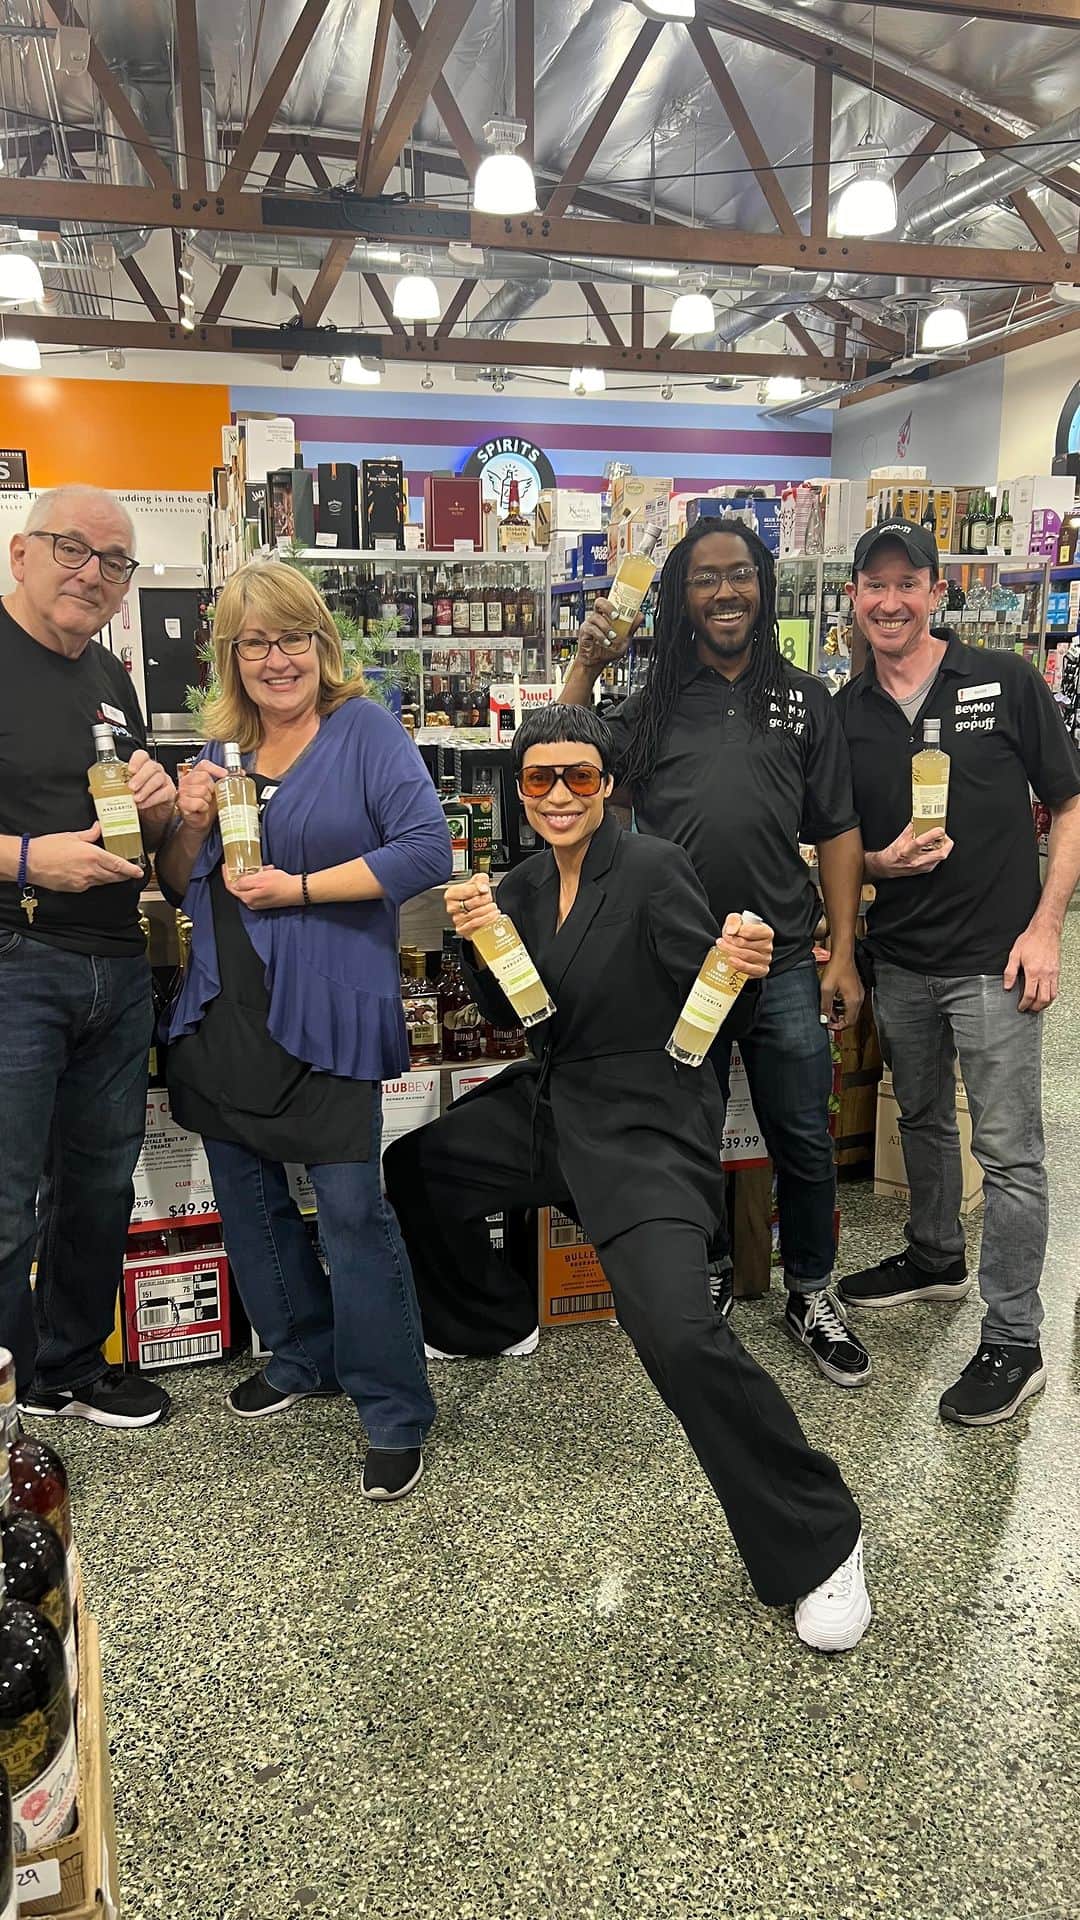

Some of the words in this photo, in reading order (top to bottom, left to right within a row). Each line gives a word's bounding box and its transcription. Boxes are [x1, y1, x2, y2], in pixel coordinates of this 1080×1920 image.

[477, 439, 540, 464] SPIRITS
[116, 494, 152, 505] udding
[155, 495, 162, 503] is
[177, 496, 193, 504] the
[782, 637, 796, 661] 8
[955, 702, 995, 715] BevMo!
[955, 716, 996, 732] gopuff
[168, 1200, 218, 1218] $49.99
[564, 1250, 598, 1262] BULLE
